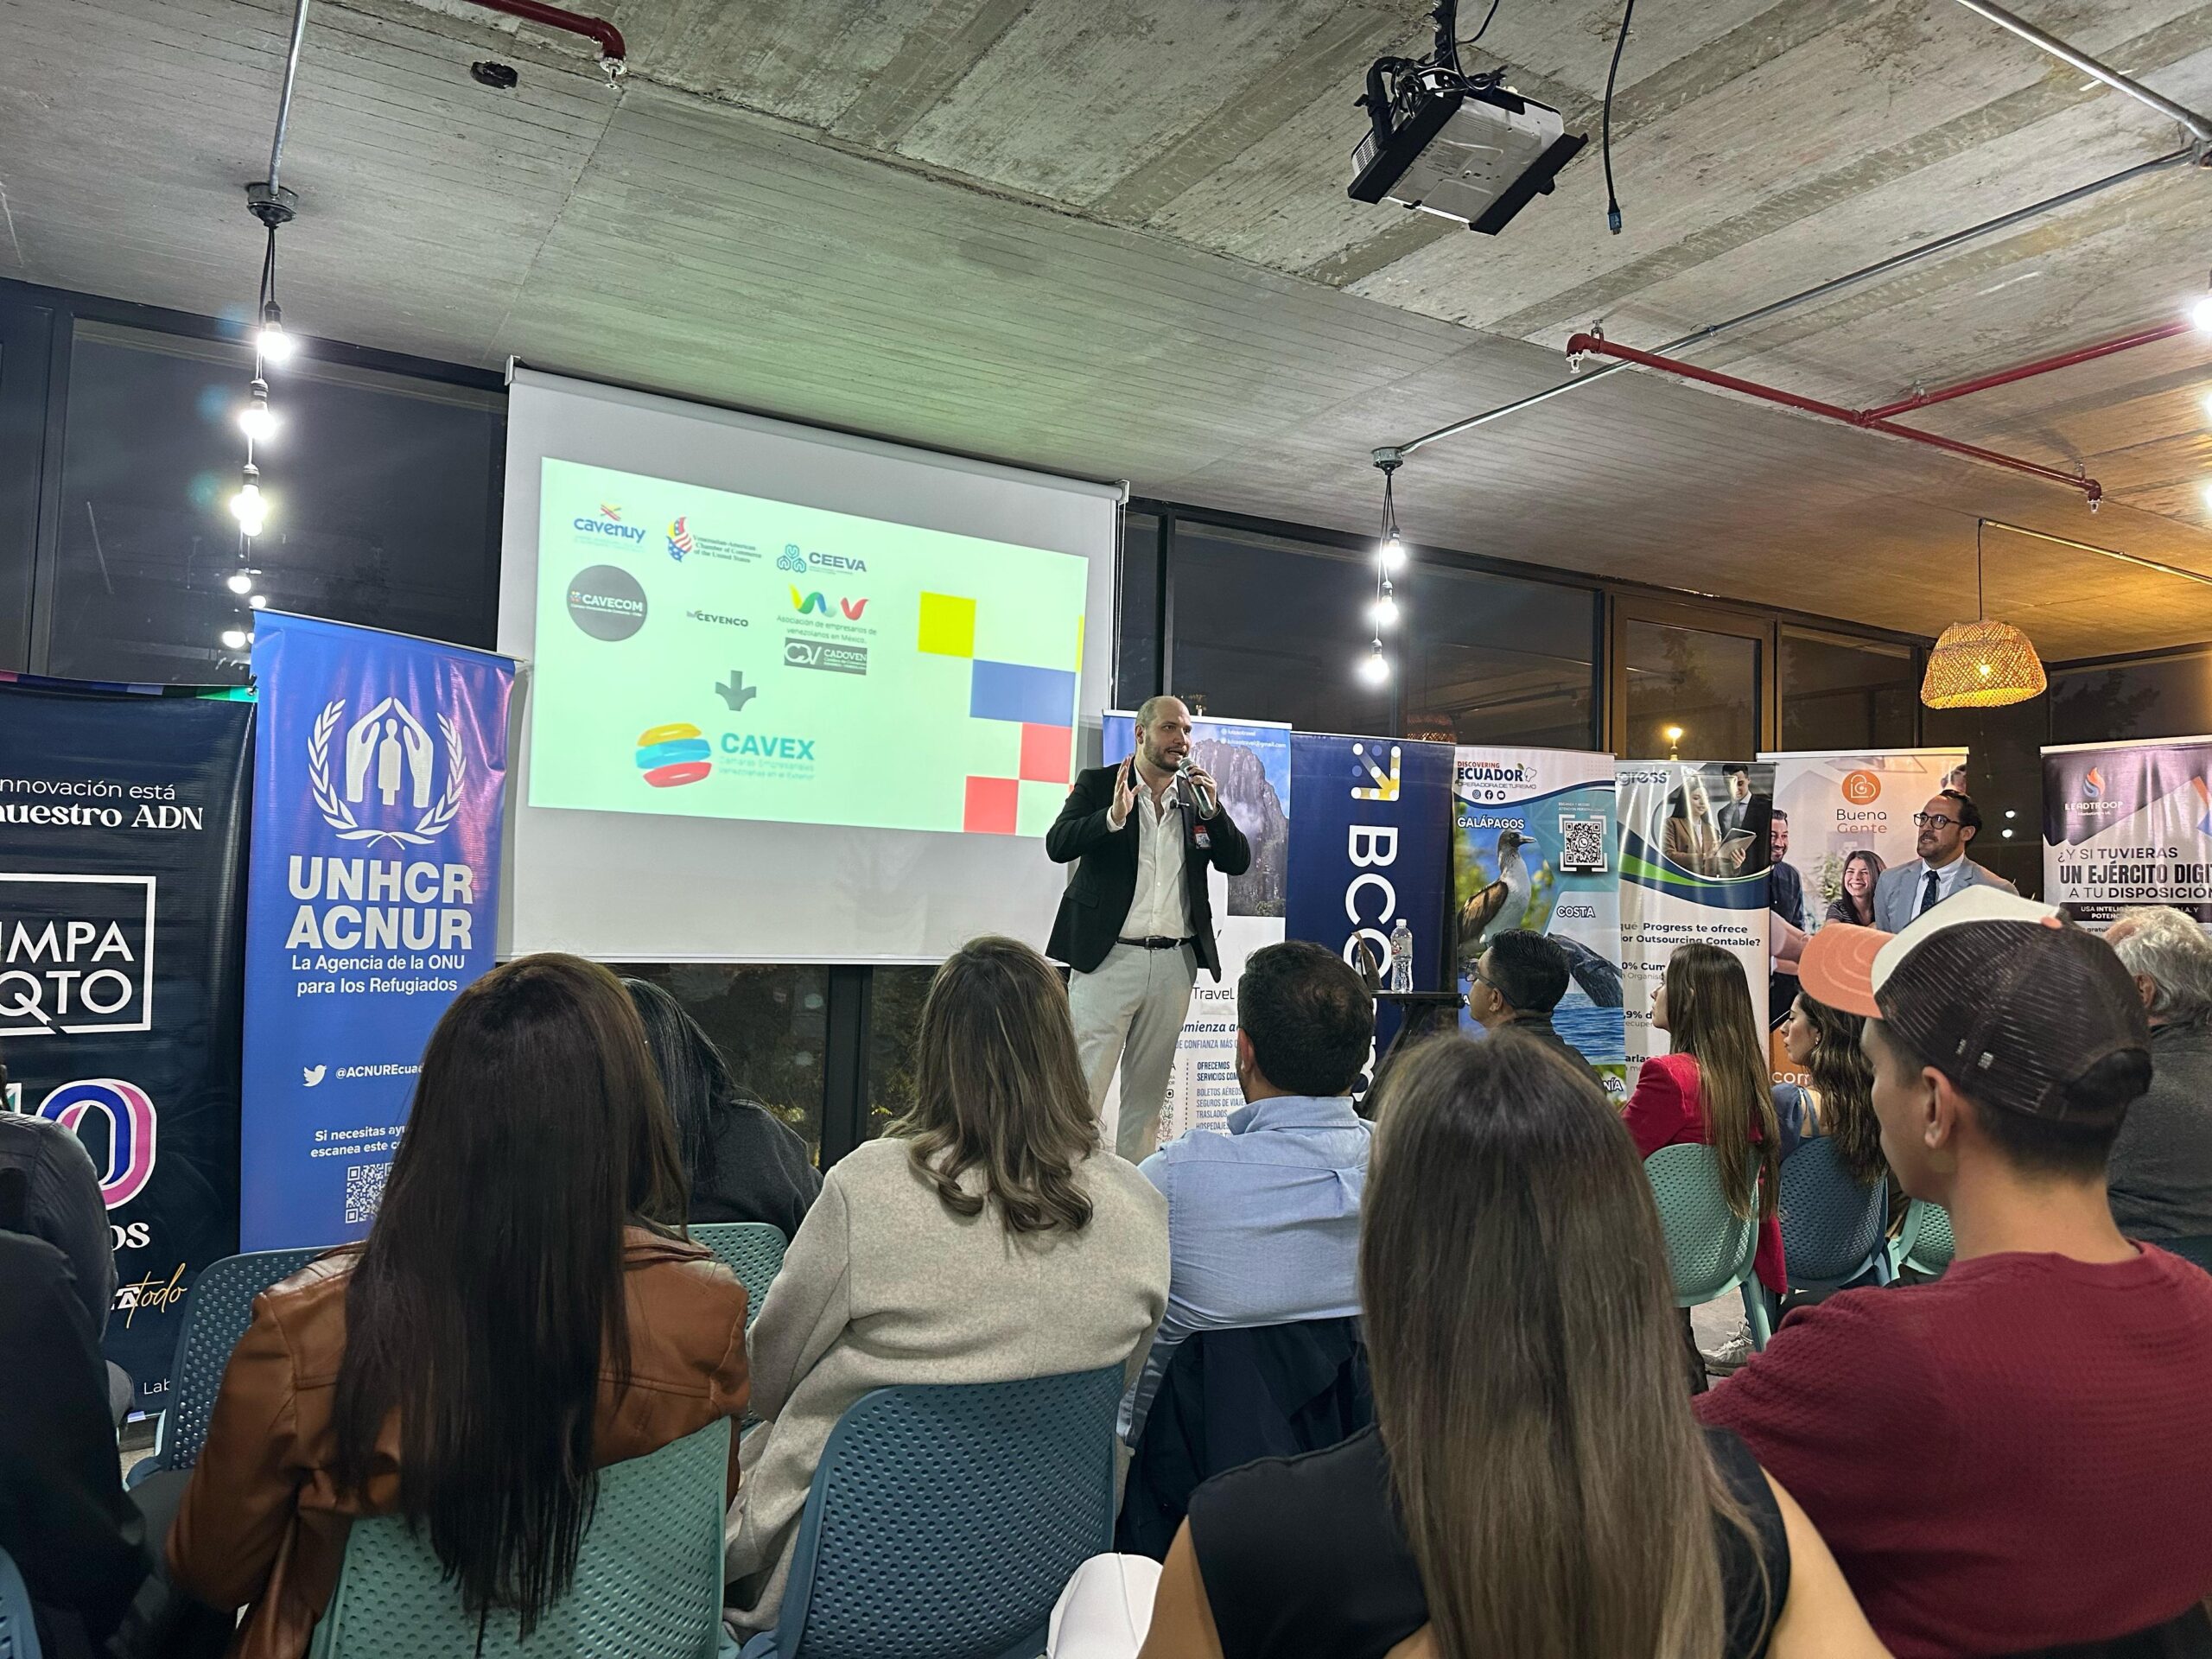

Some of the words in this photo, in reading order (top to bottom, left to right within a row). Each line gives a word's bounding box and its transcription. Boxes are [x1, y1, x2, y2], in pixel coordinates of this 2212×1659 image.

[574, 518, 645, 543] cavenuy
[696, 542, 722, 552] Chamber
[731, 548, 761, 558] Commerce
[809, 551, 867, 573] CEEVA
[582, 594, 643, 612] CAVECOM
[696, 613, 749, 626] CEVENCO
[786, 627, 830, 639] venezolanos
[823, 649, 867, 662] CADOVEN
[721, 733, 815, 760] CAVEX
[1457, 760, 1500, 769] DISCOVERING
[1458, 767, 1523, 782] ECUADOR
[1617, 772, 1668, 786] gress
[0, 779, 122, 798] nnovación
[130, 784, 175, 800] está
[2064, 801, 2124, 810] LEADTROOP
[131, 804, 203, 830] ADN
[1457, 815, 1525, 830] GALÁPAGOS
[1836, 809, 1887, 821] Buena
[1837, 823, 1887, 834] Gente
[2057, 849, 2075, 863] ¿Y
[2080, 849, 2093, 860] SI
[2097, 847, 2178, 859] TUVIERAS
[2060, 865, 2082, 884] UN
[2088, 860, 2168, 884] EJÉRCITO
[288, 855, 474, 905] UNHCR
[2069, 887, 2080, 899] A
[2083, 887, 2103, 899] TU
[1557, 906, 1596, 918] COSTA
[284, 905, 473, 950] ACNUR
[1643, 923, 1693, 933] Progress
[1696, 924, 1708, 932] te
[1711, 925, 1748, 933] ofrece
[0, 920, 135, 963] MPA
[1636, 935, 1703, 945] Outsourcing
[1706, 937, 1761, 946] Contable?
[292, 956, 311, 970] La
[315, 955, 383, 973] Agencia
[387, 956, 407, 970] de
[410, 955, 424, 969] la
[428, 955, 465, 969] ONU
[1640, 962, 1666, 971] Cum
[297, 980, 335, 997] para
[340, 978, 365, 994] los
[370, 977, 458, 995] Refugiados
[1192, 987, 1235, 1000] Travel
[0, 969, 132, 1025] QTO
[1181, 1020, 1226, 1033] mienza
[1184, 1039, 1218, 1049] CONFIANZA
[1220, 1038, 1233, 1049] MÁS
[335, 1063, 424, 1079] @ACNUREcuad
[1197, 1061, 1230, 1071] OFRECEMOS
[1197, 1072, 1225, 1082] SERVICIOS
[1197, 1088, 1221, 1096] BOLETOS
[1196, 1099, 1221, 1108] SEGUROS
[1223, 1098, 1229, 1107] DE
[1196, 1109, 1228, 1118] TRASLADOS
[315, 1129, 327, 1141] Si
[331, 1126, 385, 1141] necesitas
[310, 1145, 361, 1157] escanea
[364, 1141, 388, 1153] este
[125, 1262, 188, 1329] todo
[143, 1378, 170, 1395] Lab
